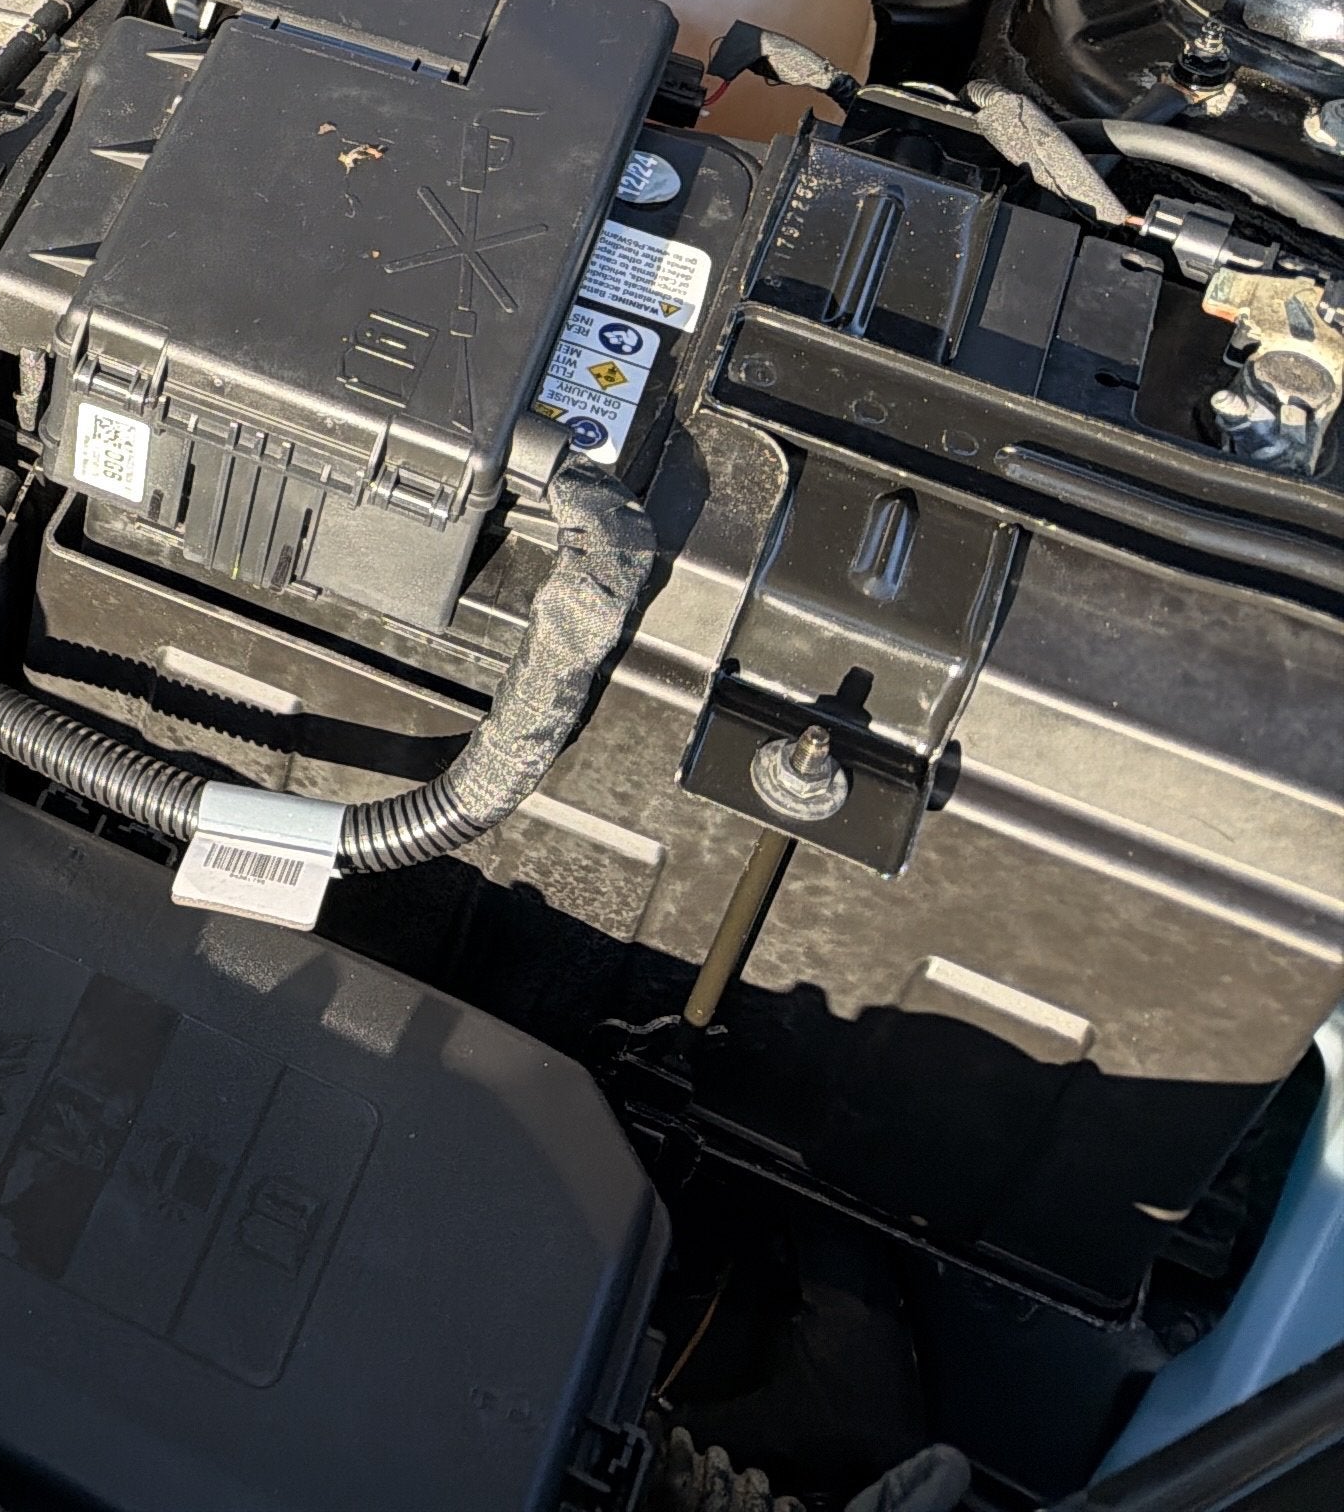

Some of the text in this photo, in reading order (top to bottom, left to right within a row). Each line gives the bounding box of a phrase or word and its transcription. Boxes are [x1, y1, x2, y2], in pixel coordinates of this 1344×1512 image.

[616, 153, 658, 197] 12/24
[616, 252, 642, 265] other
[619, 261, 629, 269] to
[640, 251, 663, 263] after
[642, 260, 654, 268] or
[597, 263, 626, 277] which
[621, 287, 656, 304] related
[622, 279, 672, 301] chemicals
[606, 292, 659, 314] WARNING:
[554, 380, 621, 408] OR INJURY.
[545, 389, 617, 420] CAN CAUSE
